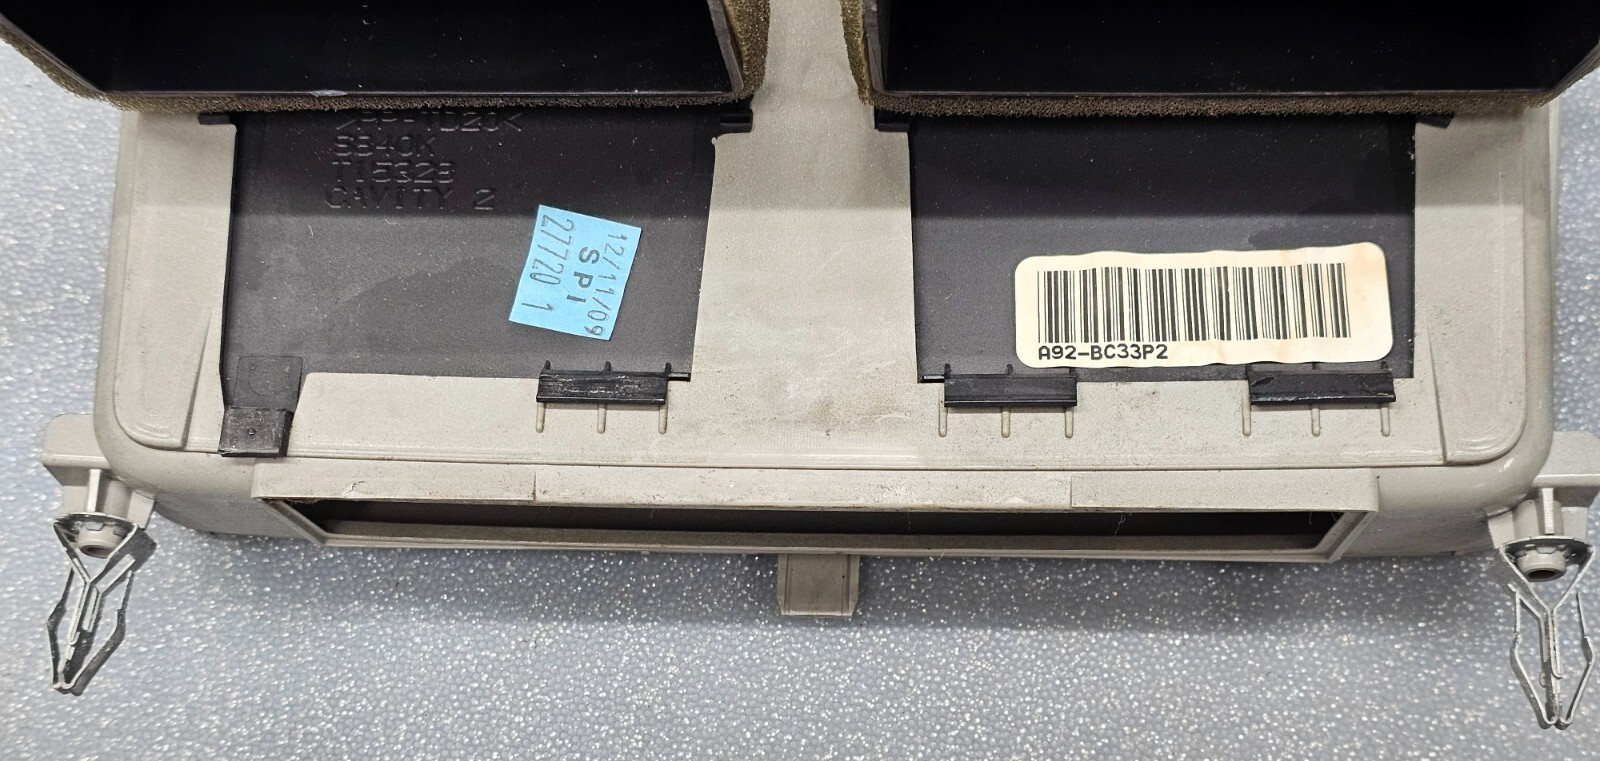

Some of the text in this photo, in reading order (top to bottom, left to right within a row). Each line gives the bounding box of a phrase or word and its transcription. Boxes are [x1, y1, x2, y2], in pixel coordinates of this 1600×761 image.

[324, 185, 498, 210] CAVITY 2
[529, 214, 576, 286] 27720
[584, 233, 629, 336] 12/11/09
[1038, 342, 1168, 361] A92-BC33P2
